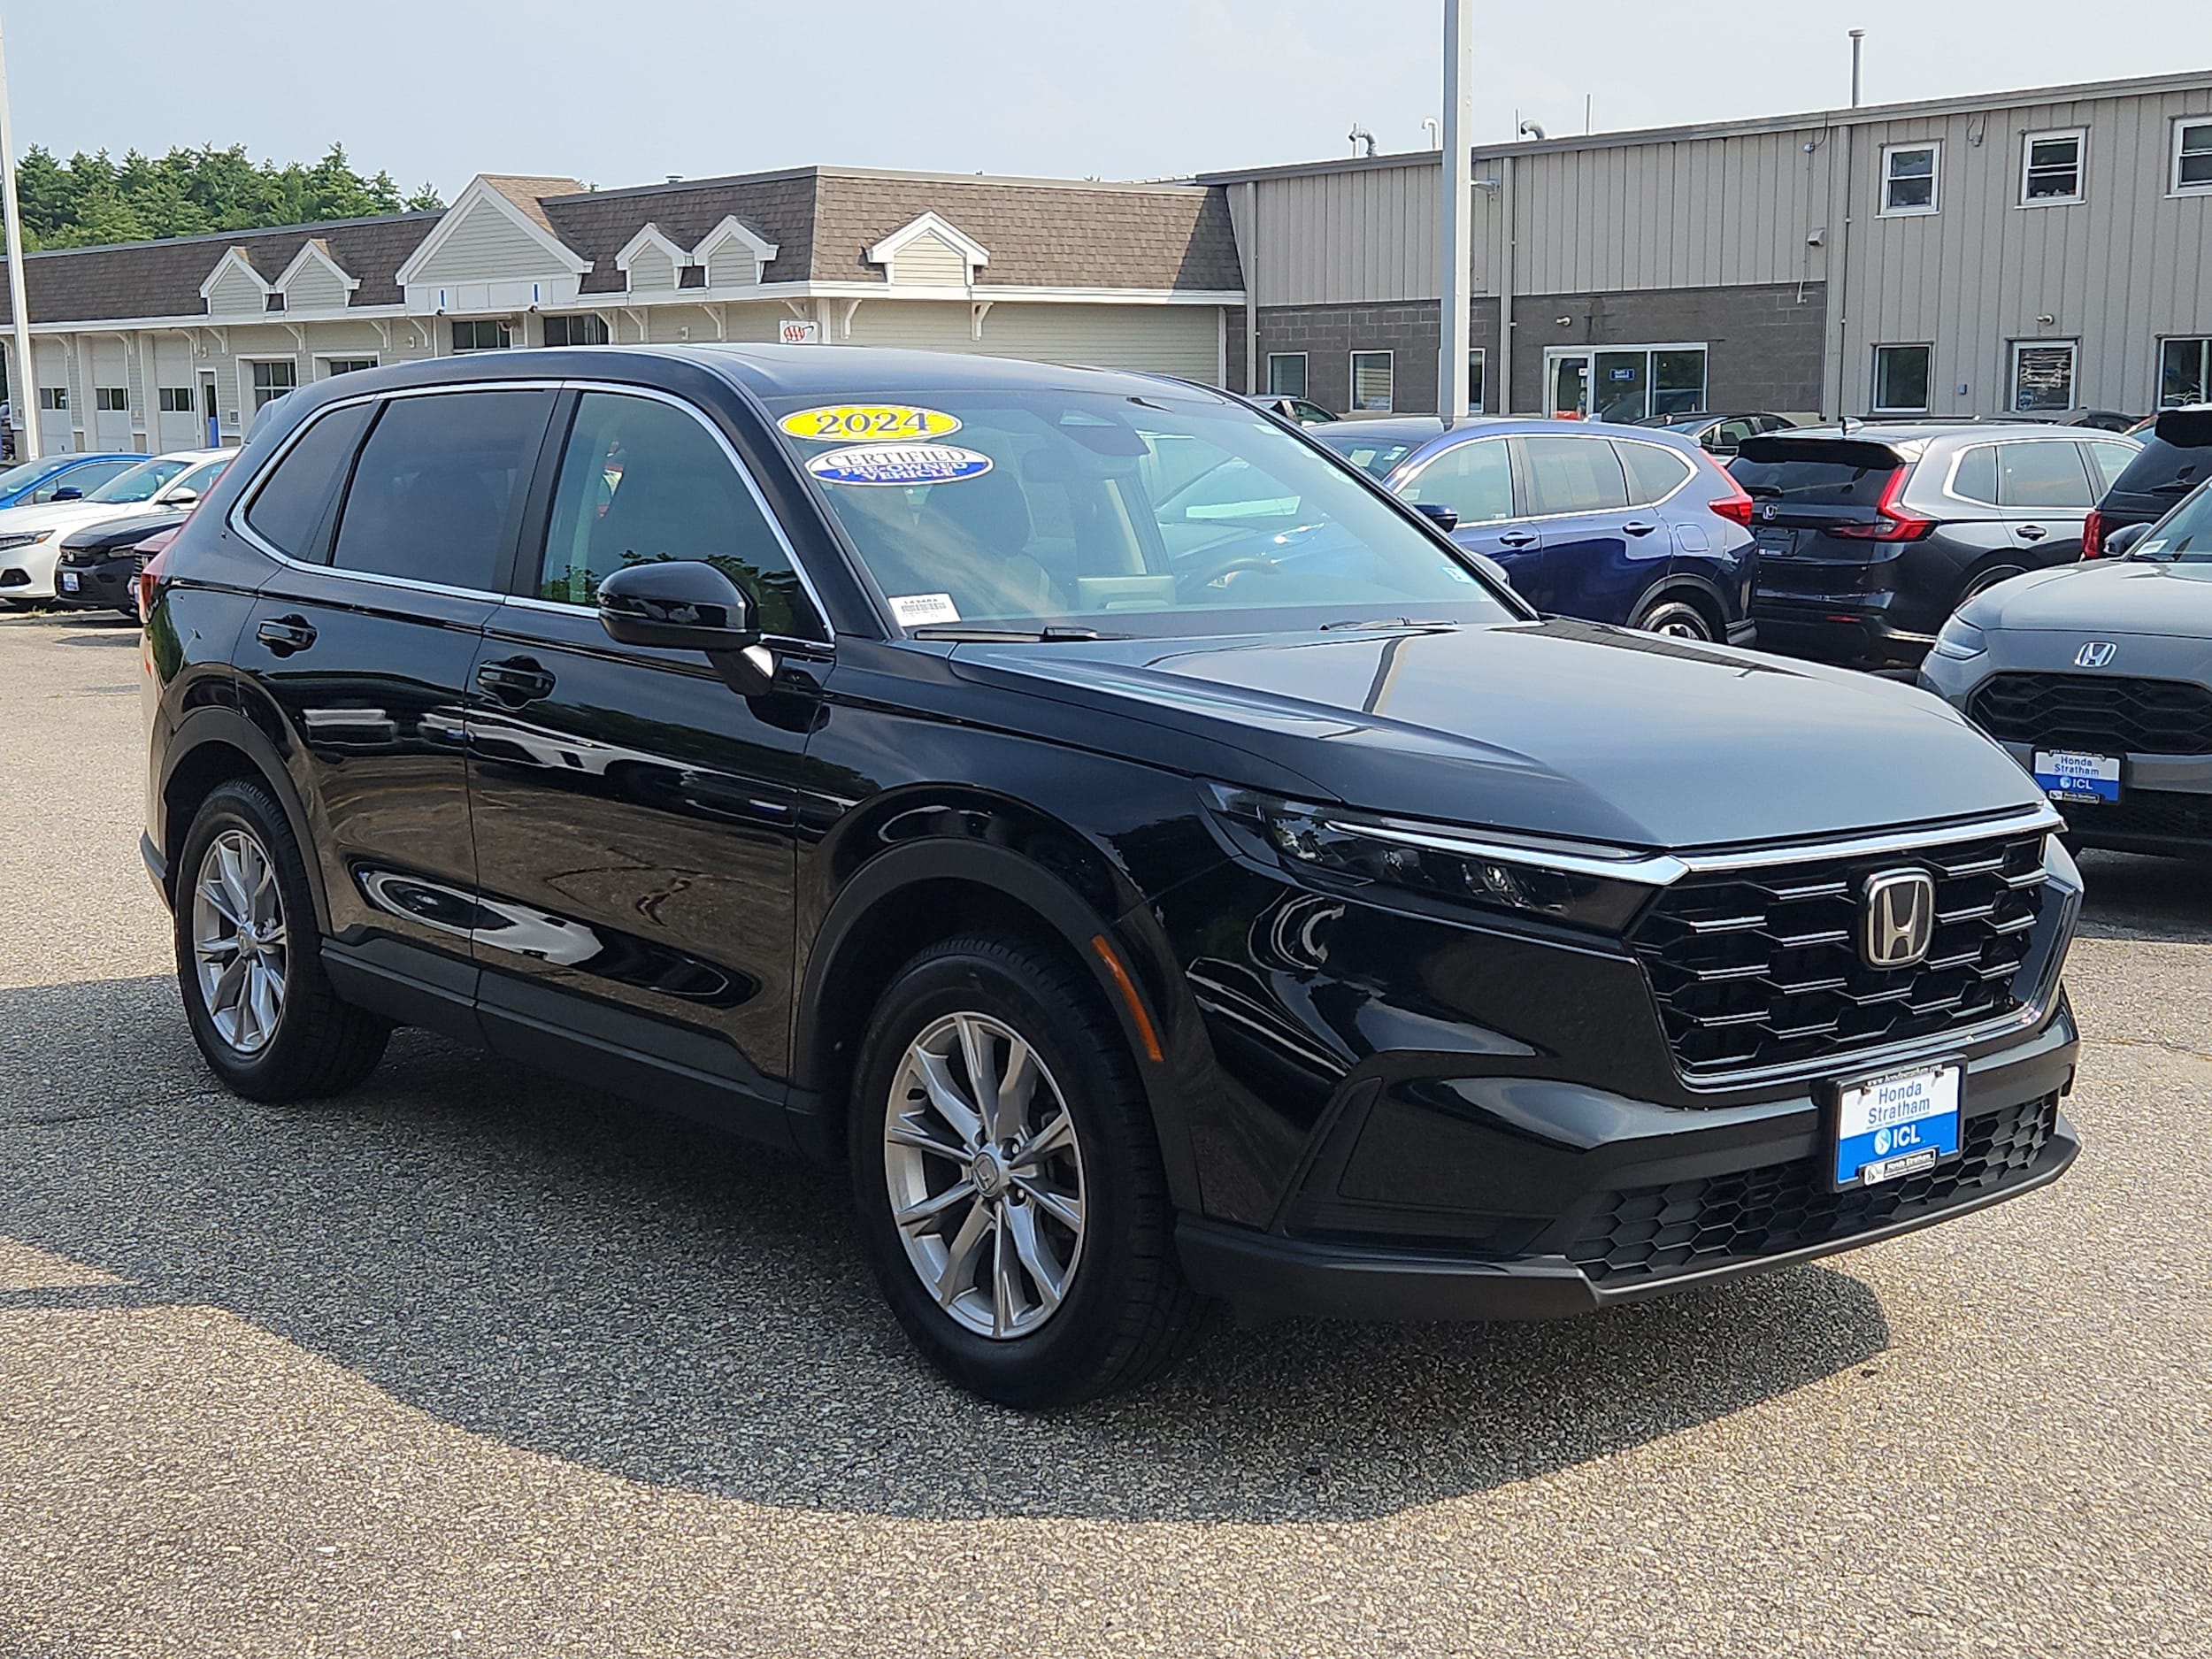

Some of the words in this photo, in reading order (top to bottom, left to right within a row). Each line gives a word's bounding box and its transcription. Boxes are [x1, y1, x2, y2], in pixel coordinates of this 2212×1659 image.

[816, 412, 931, 434] 2024
[826, 449, 966, 467] CERTIFIED
[838, 462, 968, 476] PRE-OWNED
[863, 468, 956, 480] VEHICLE
[2061, 756, 2093, 767] Honda
[2055, 764, 2100, 776] Stratham
[2072, 779, 2093, 790] ICL
[1878, 1080, 1922, 1105] Honda
[1868, 1097, 1931, 1125] Stratham
[1893, 1124, 1921, 1149] ICL
